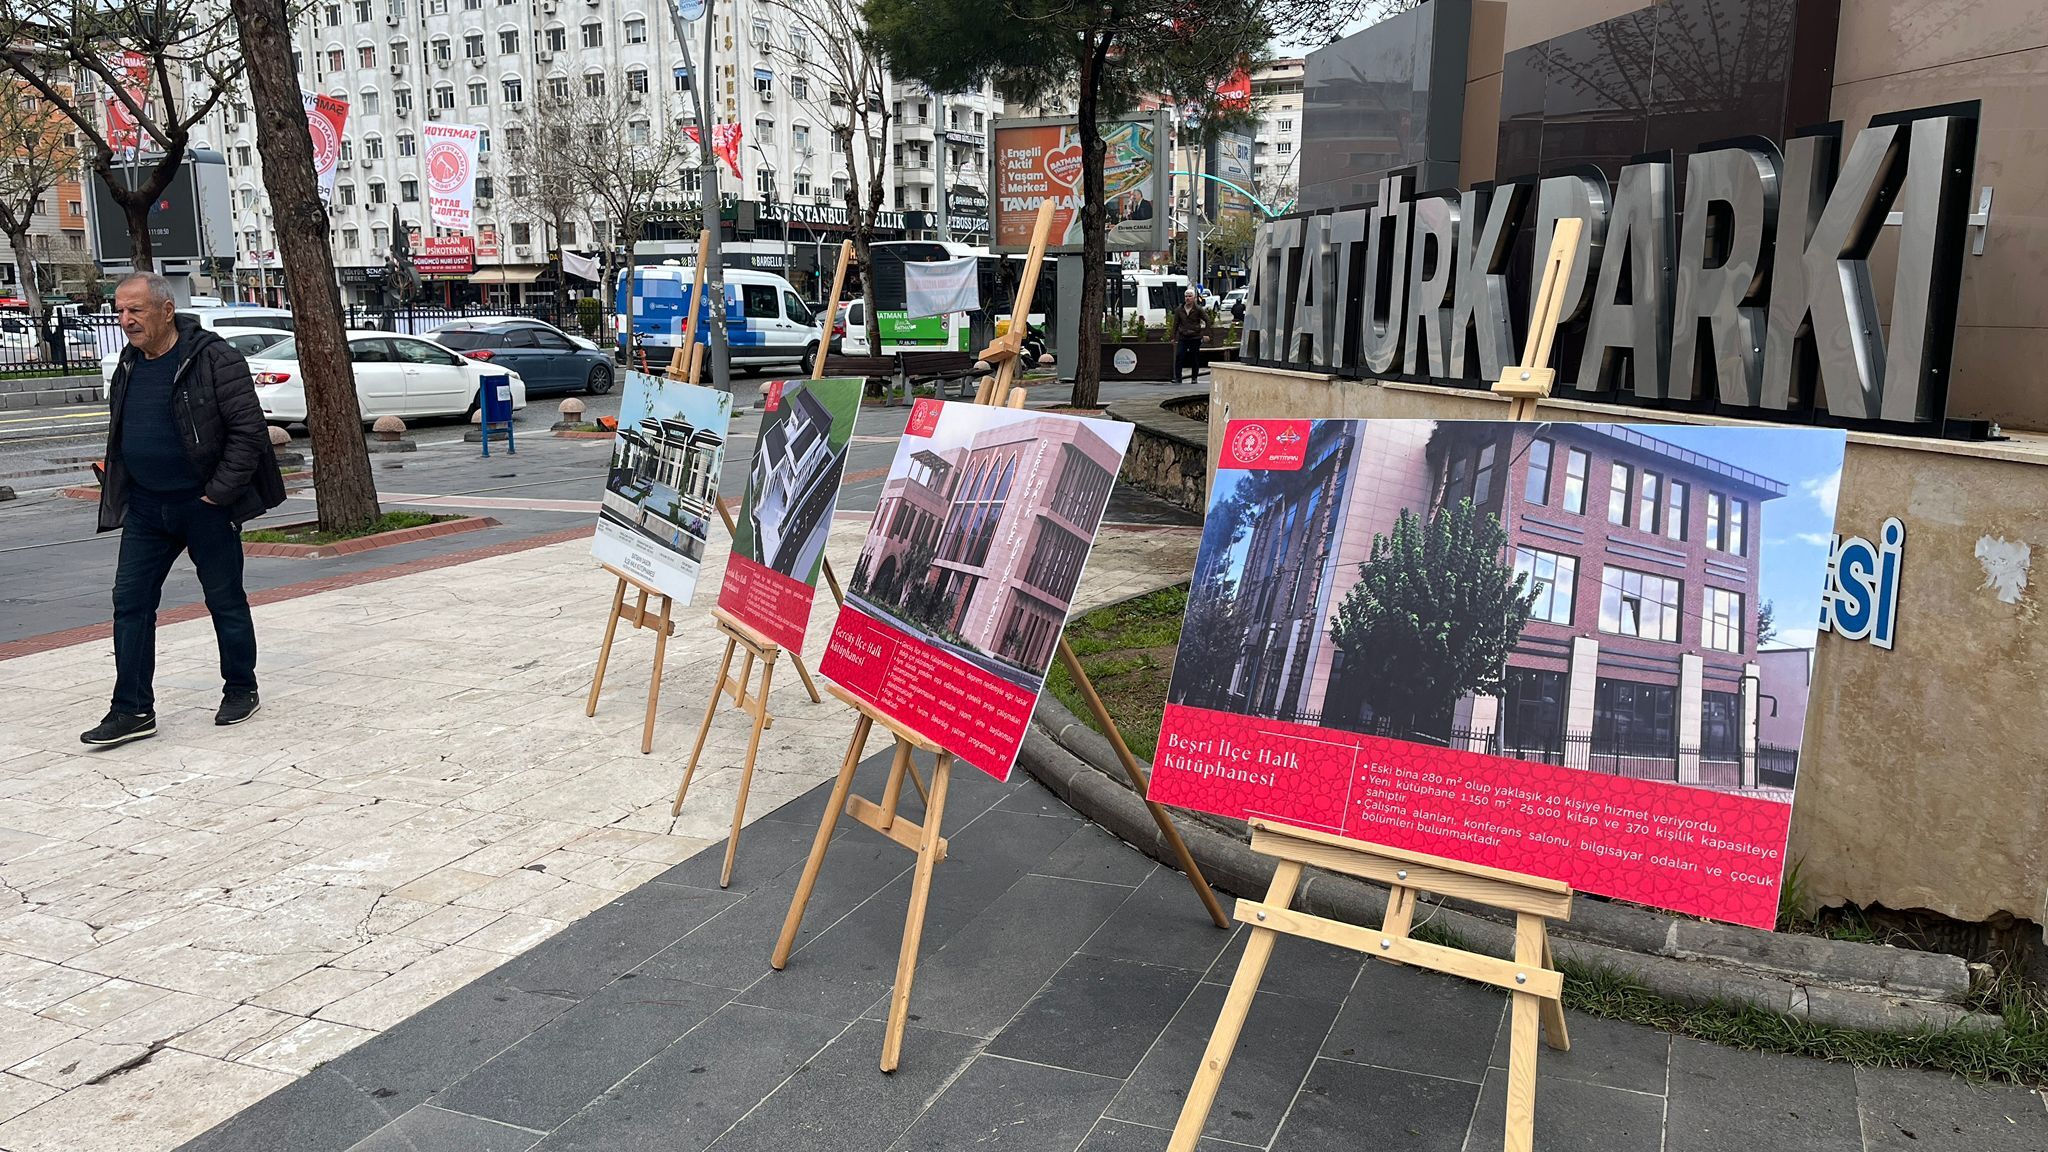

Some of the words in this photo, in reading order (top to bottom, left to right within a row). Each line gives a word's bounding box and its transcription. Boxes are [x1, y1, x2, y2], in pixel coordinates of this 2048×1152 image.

[1007, 146, 1042, 161] Engelli
[1007, 159, 1033, 169] Aktif
[1007, 171, 1044, 183] Yaşam
[1007, 181, 1048, 193] Merkezi
[1240, 174, 1522, 384] ATATÜRK
[1528, 112, 1962, 424] PARKI
[866, 642, 883, 658] Halk
[1168, 733, 1213, 754] Beşri
[1219, 739, 1251, 762] İlçe
[1258, 749, 1300, 770] Halk
[1164, 753, 1276, 787] Kütüphanesi
[1370, 763, 1392, 774] Eski
[1395, 768, 1418, 780] bina
[1422, 773, 1443, 784] 280
[1465, 780, 1491, 793] olup
[1494, 786, 1542, 802] yaklaşık
[1545, 796, 1561, 806] 40
[1564, 797, 1601, 813] kişiye
[1604, 803, 1648, 821] hizmet
[1362, 811, 1414, 829] bölümleri
[1369, 775, 1391, 787] Yeni
[1396, 780, 1455, 799] kütüphane
[1566, 811, 1598, 826] kitap
[1605, 819, 1620, 829] ve
[1625, 822, 1649, 834] 370
[1655, 827, 1694, 843] kişilik
[1701, 834, 1778, 859] kapasiteye
[1364, 799, 1407, 815] Çalışma
[1463, 817, 1522, 838] konferans
[1580, 840, 1643, 861] bilgisayar
[1650, 854, 1698, 872] odaları
[1705, 865, 1722, 877] ve
[1730, 870, 1774, 887] çocuk
